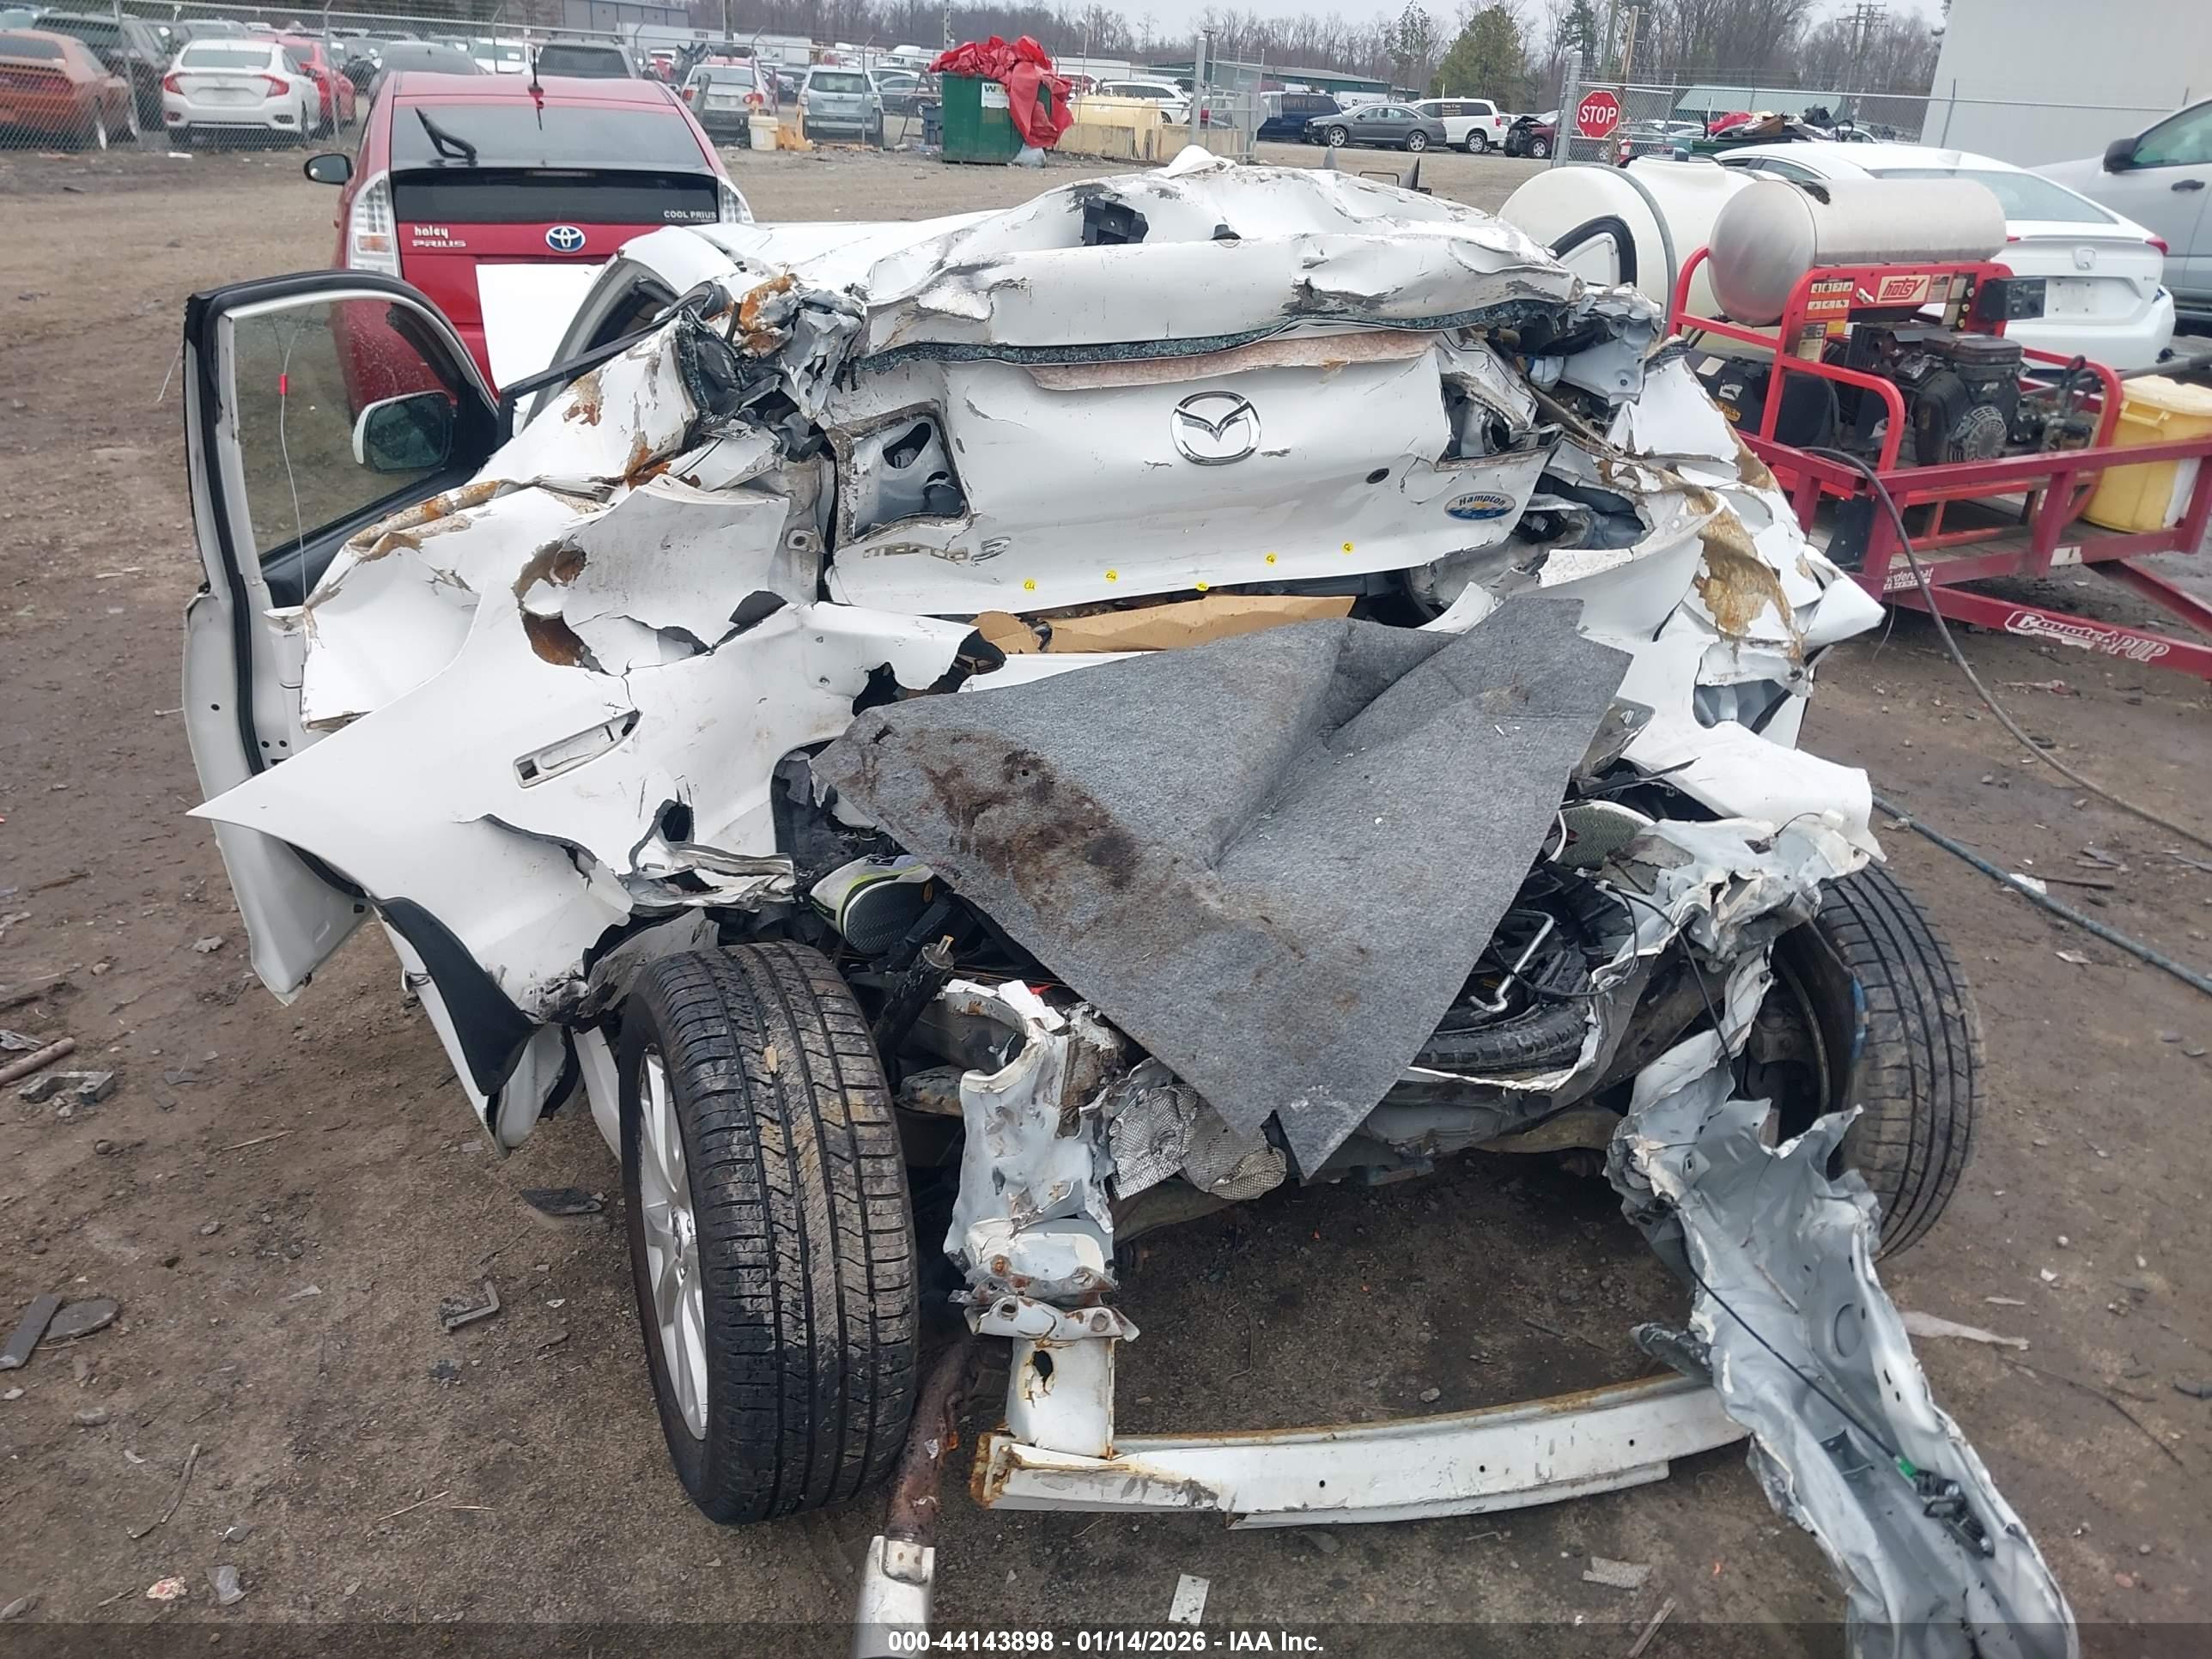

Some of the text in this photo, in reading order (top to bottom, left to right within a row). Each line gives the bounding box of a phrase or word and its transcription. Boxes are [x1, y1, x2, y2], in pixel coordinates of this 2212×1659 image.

[1580, 105, 1617, 125] STOP
[664, 210, 717, 219] COOL PRIUS
[412, 240, 466, 248] PRIUS
[1459, 495, 1506, 507] Hampton
[2109, 635, 2170, 662] PUP
